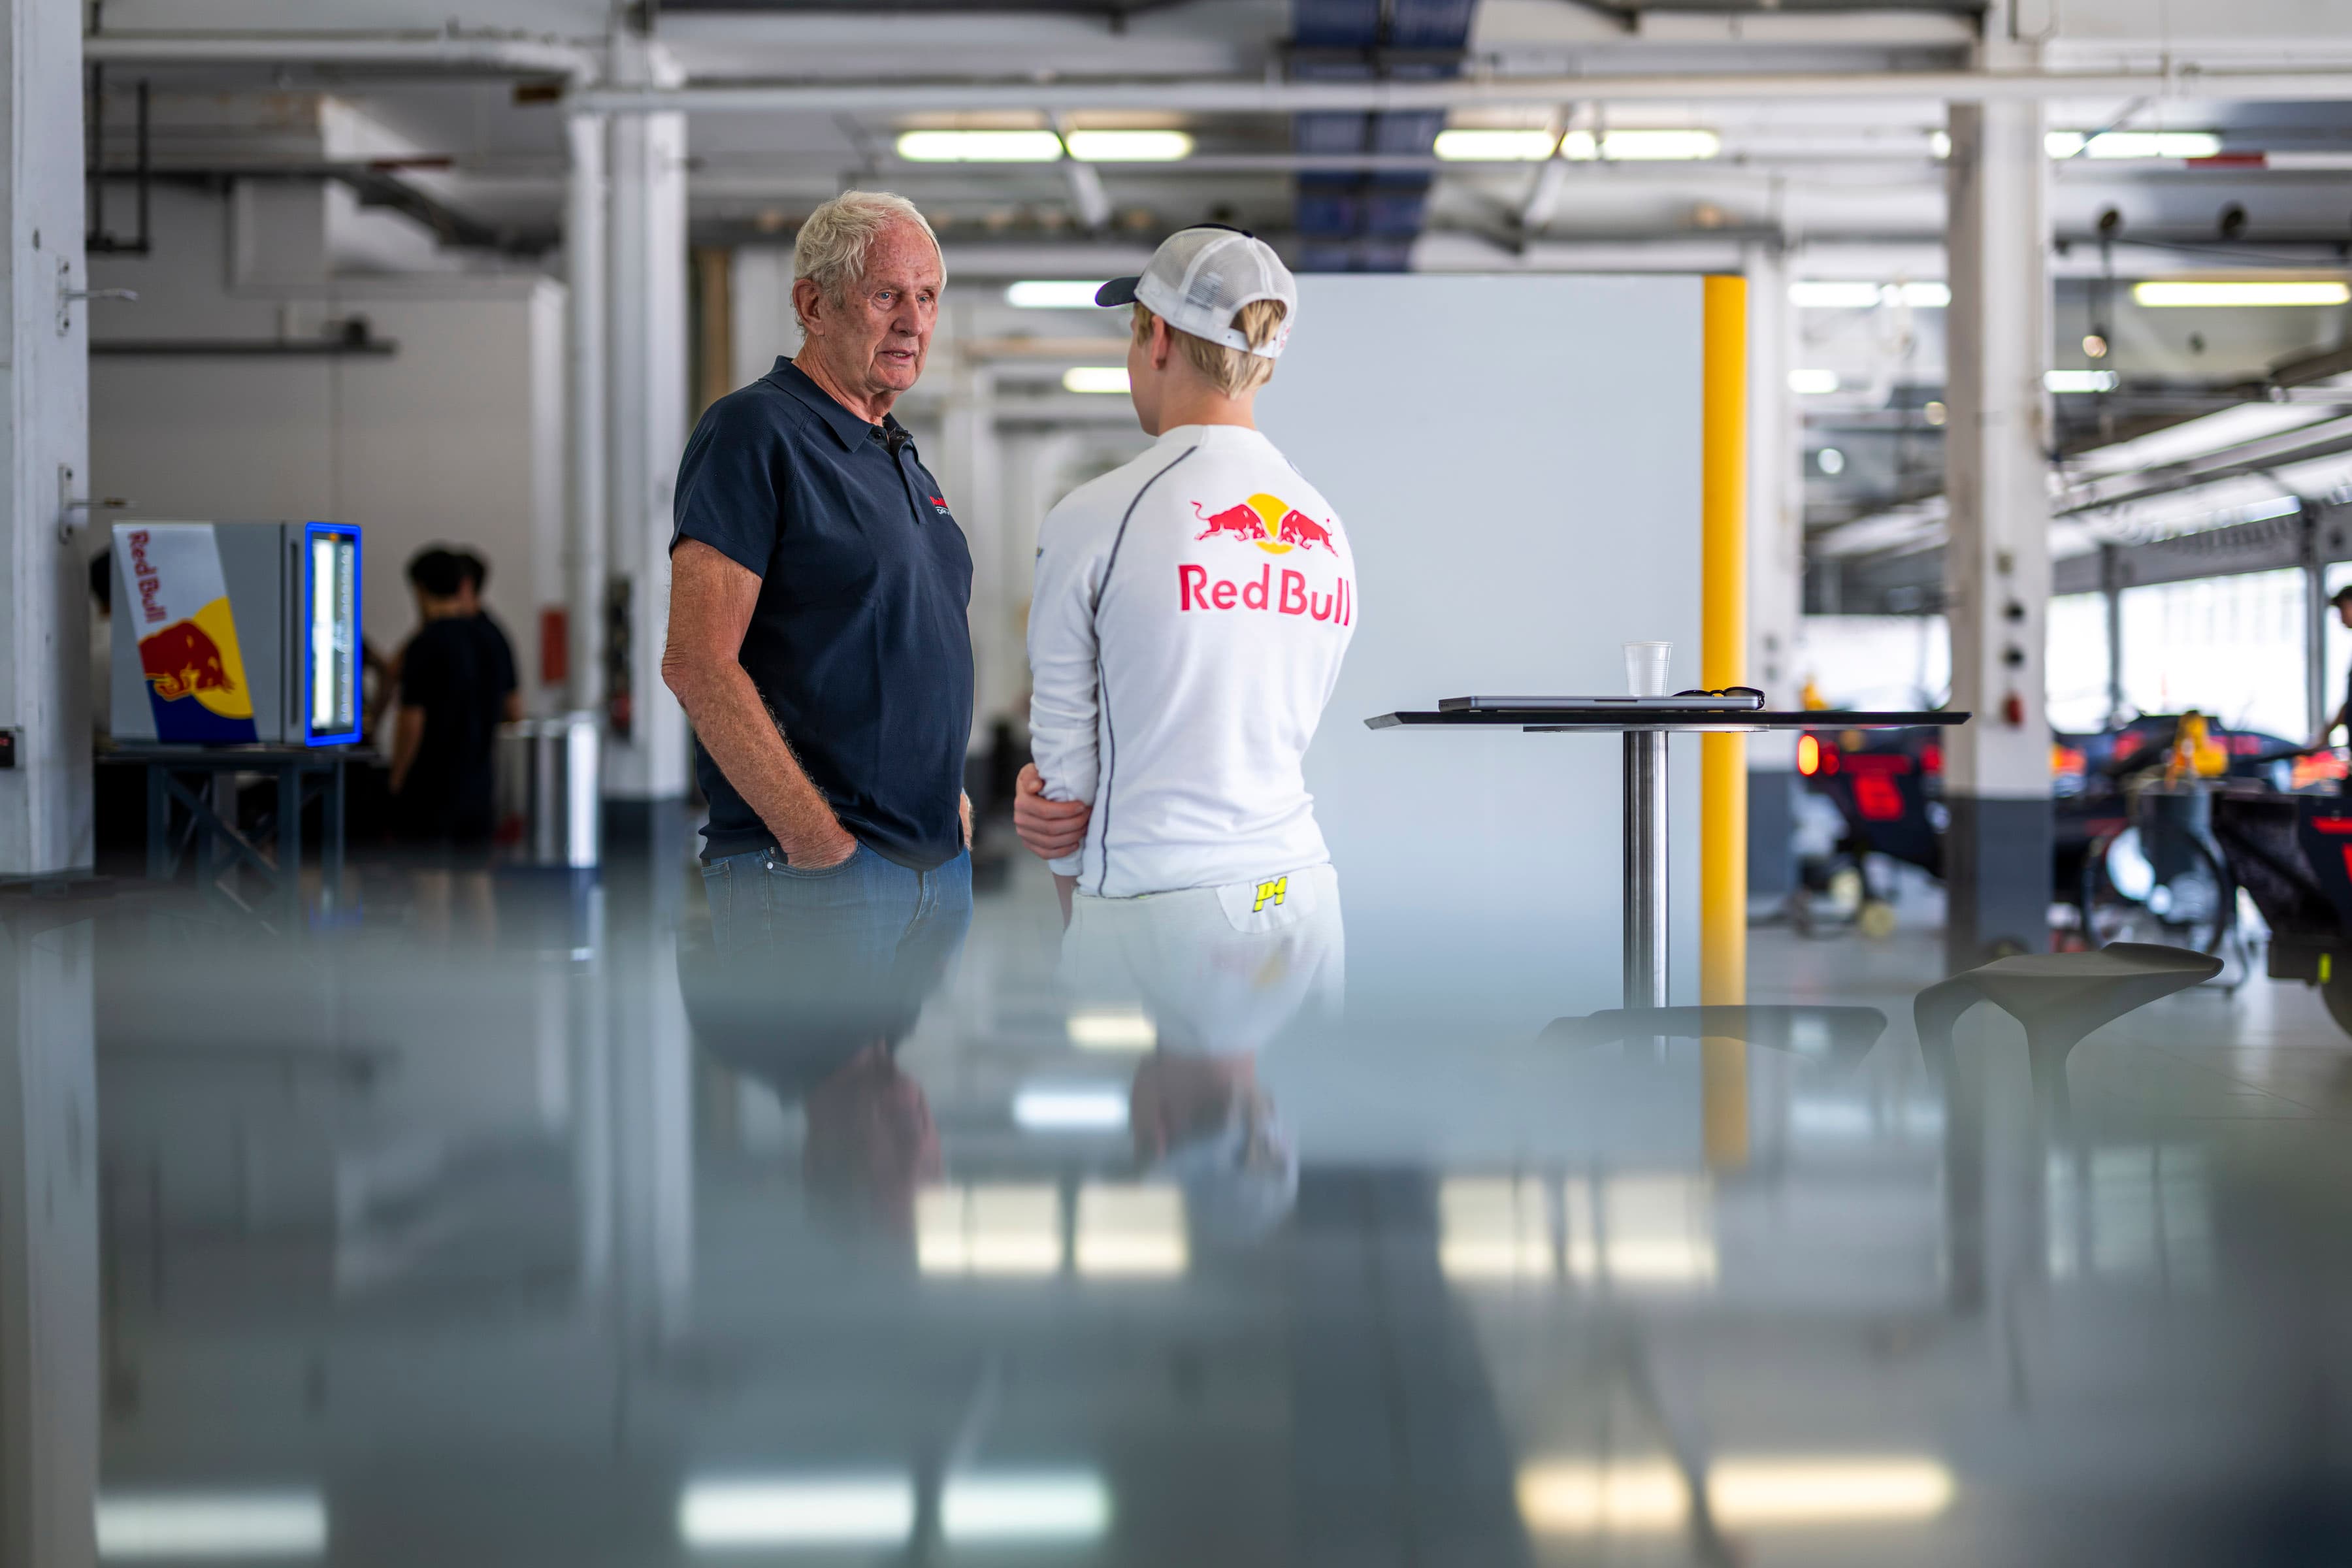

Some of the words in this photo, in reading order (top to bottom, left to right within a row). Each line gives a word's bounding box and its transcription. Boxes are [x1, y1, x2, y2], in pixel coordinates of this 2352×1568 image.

[128, 530, 157, 578] Red
[138, 578, 167, 623] Bull
[1178, 563, 1270, 612] Red
[1278, 568, 1350, 627] Bull
